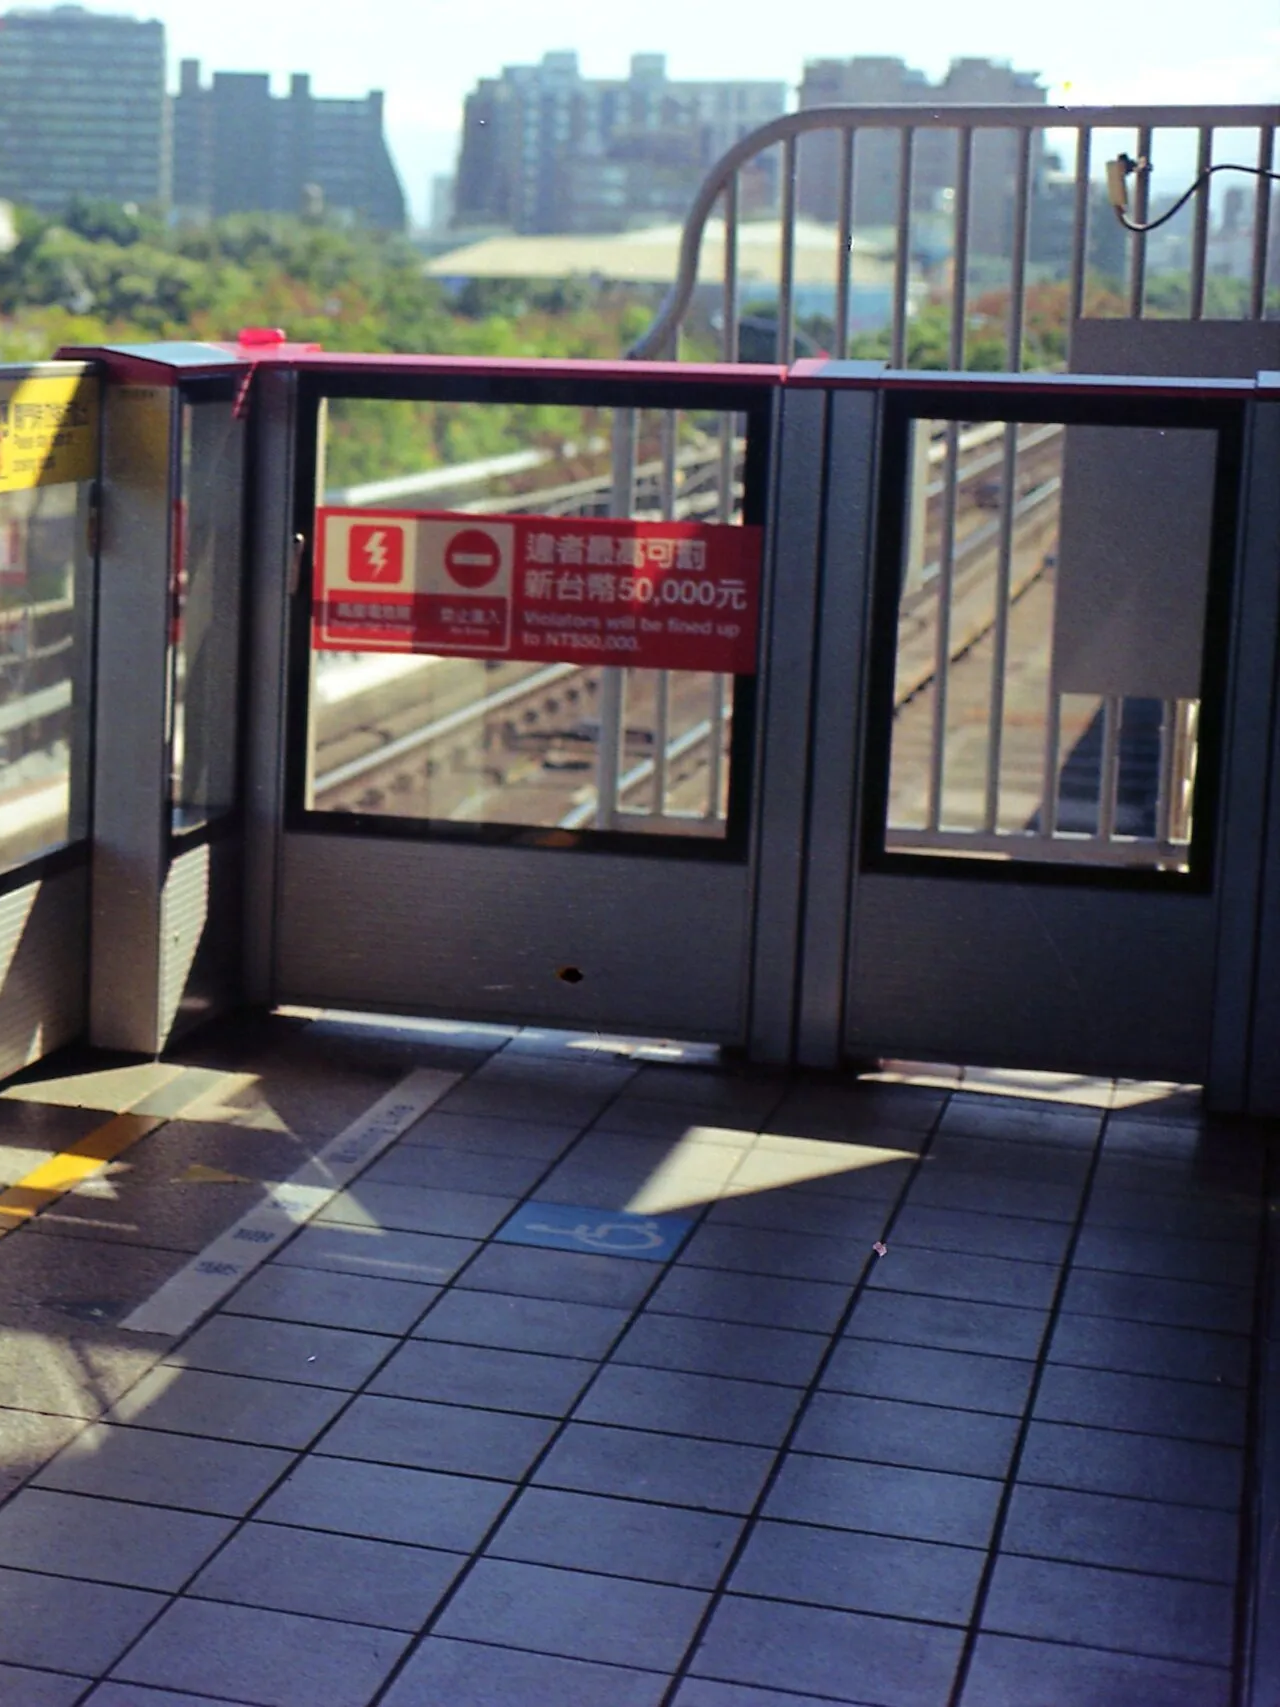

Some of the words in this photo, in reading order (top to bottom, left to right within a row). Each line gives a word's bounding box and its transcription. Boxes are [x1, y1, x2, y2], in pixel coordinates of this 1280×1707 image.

[523, 569, 748, 611] 新台幣50,000元
[522, 631, 539, 646] to
[523, 609, 600, 629] Violators
[606, 615, 636, 631] will
[639, 617, 663, 632] be
[668, 616, 712, 636] fined
[716, 623, 741, 640] up
